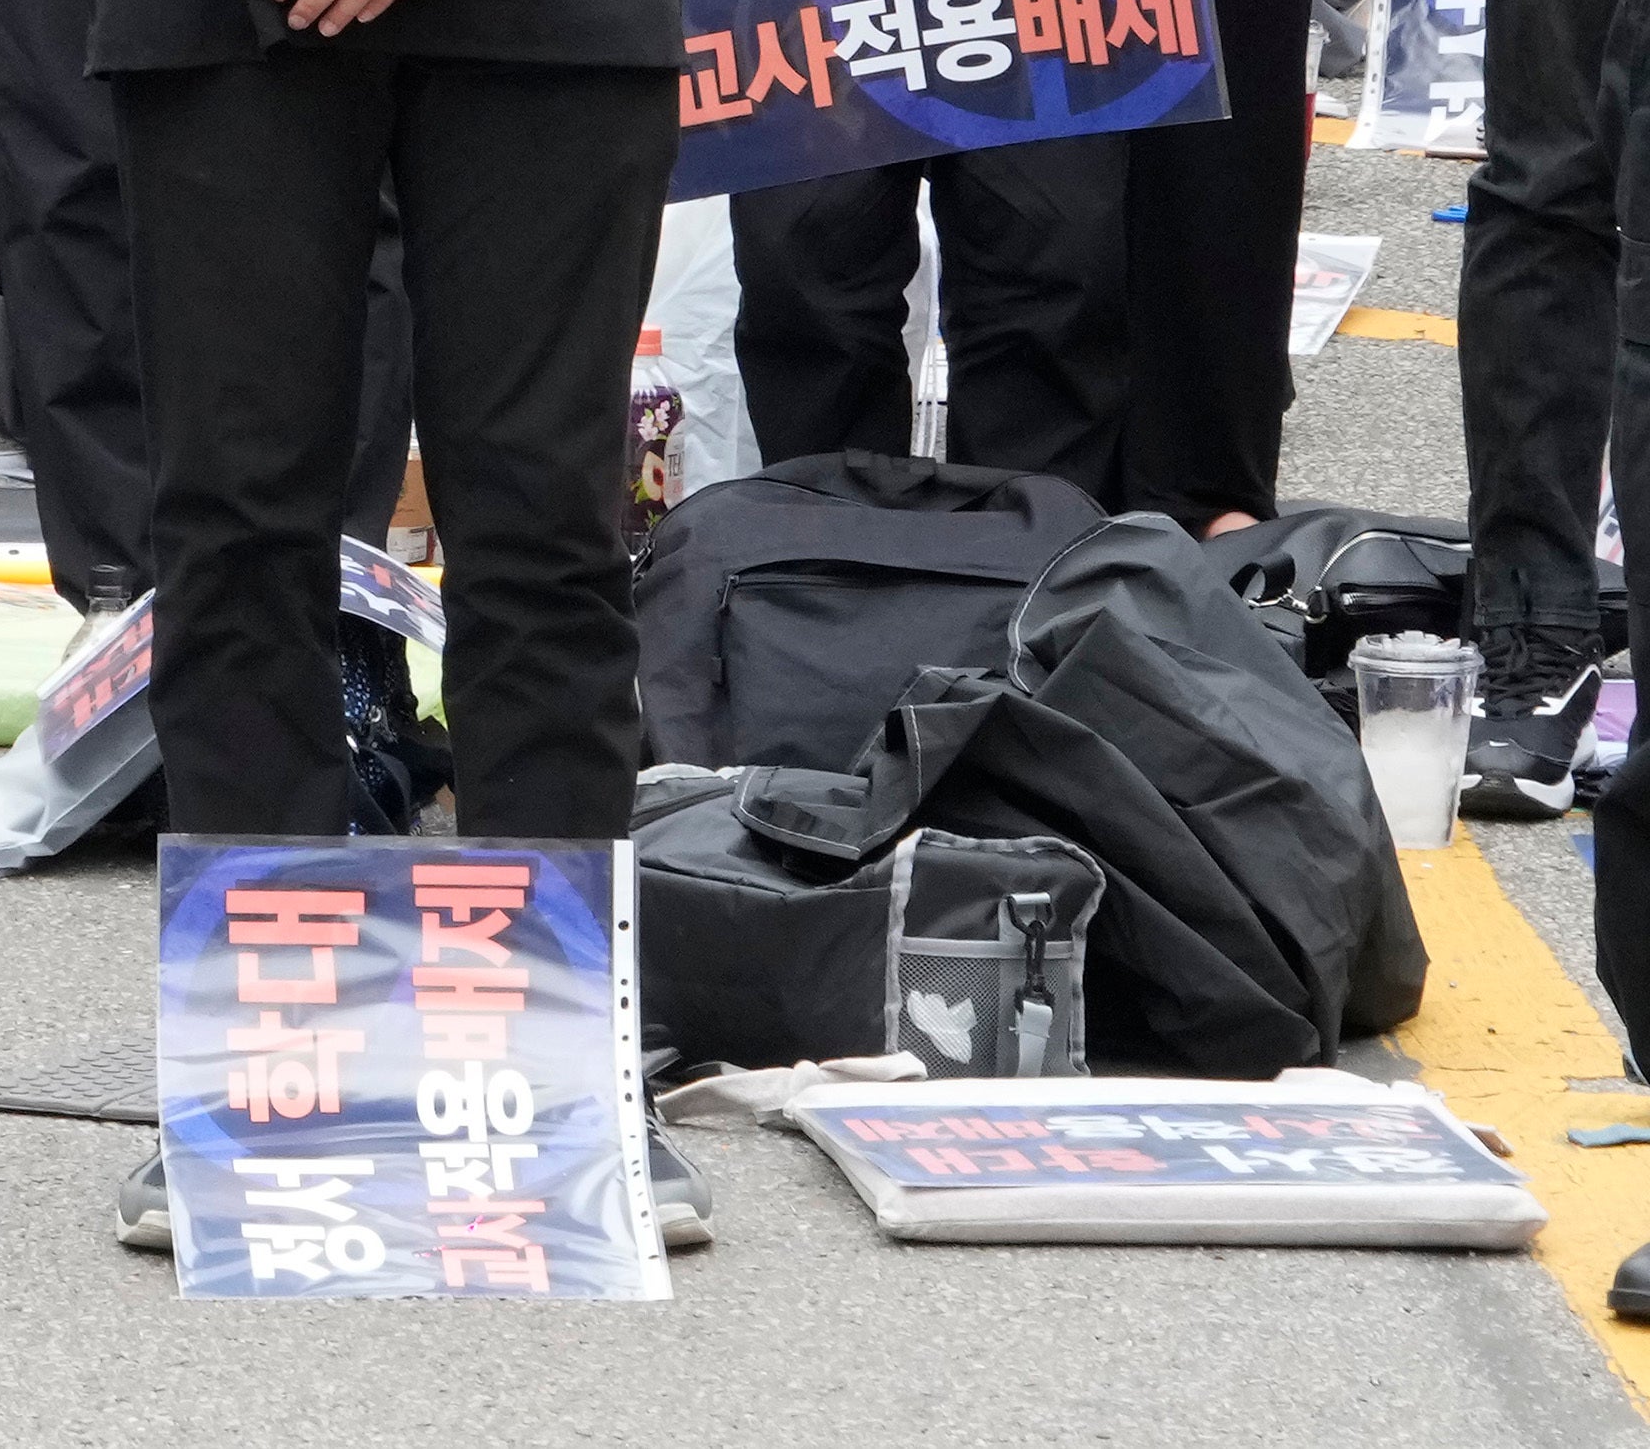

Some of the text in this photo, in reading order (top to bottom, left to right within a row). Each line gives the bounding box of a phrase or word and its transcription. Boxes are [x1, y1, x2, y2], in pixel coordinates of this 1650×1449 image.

[225, 889, 387, 1282] 정서 학대
[904, 1145, 1169, 1176] 학대
